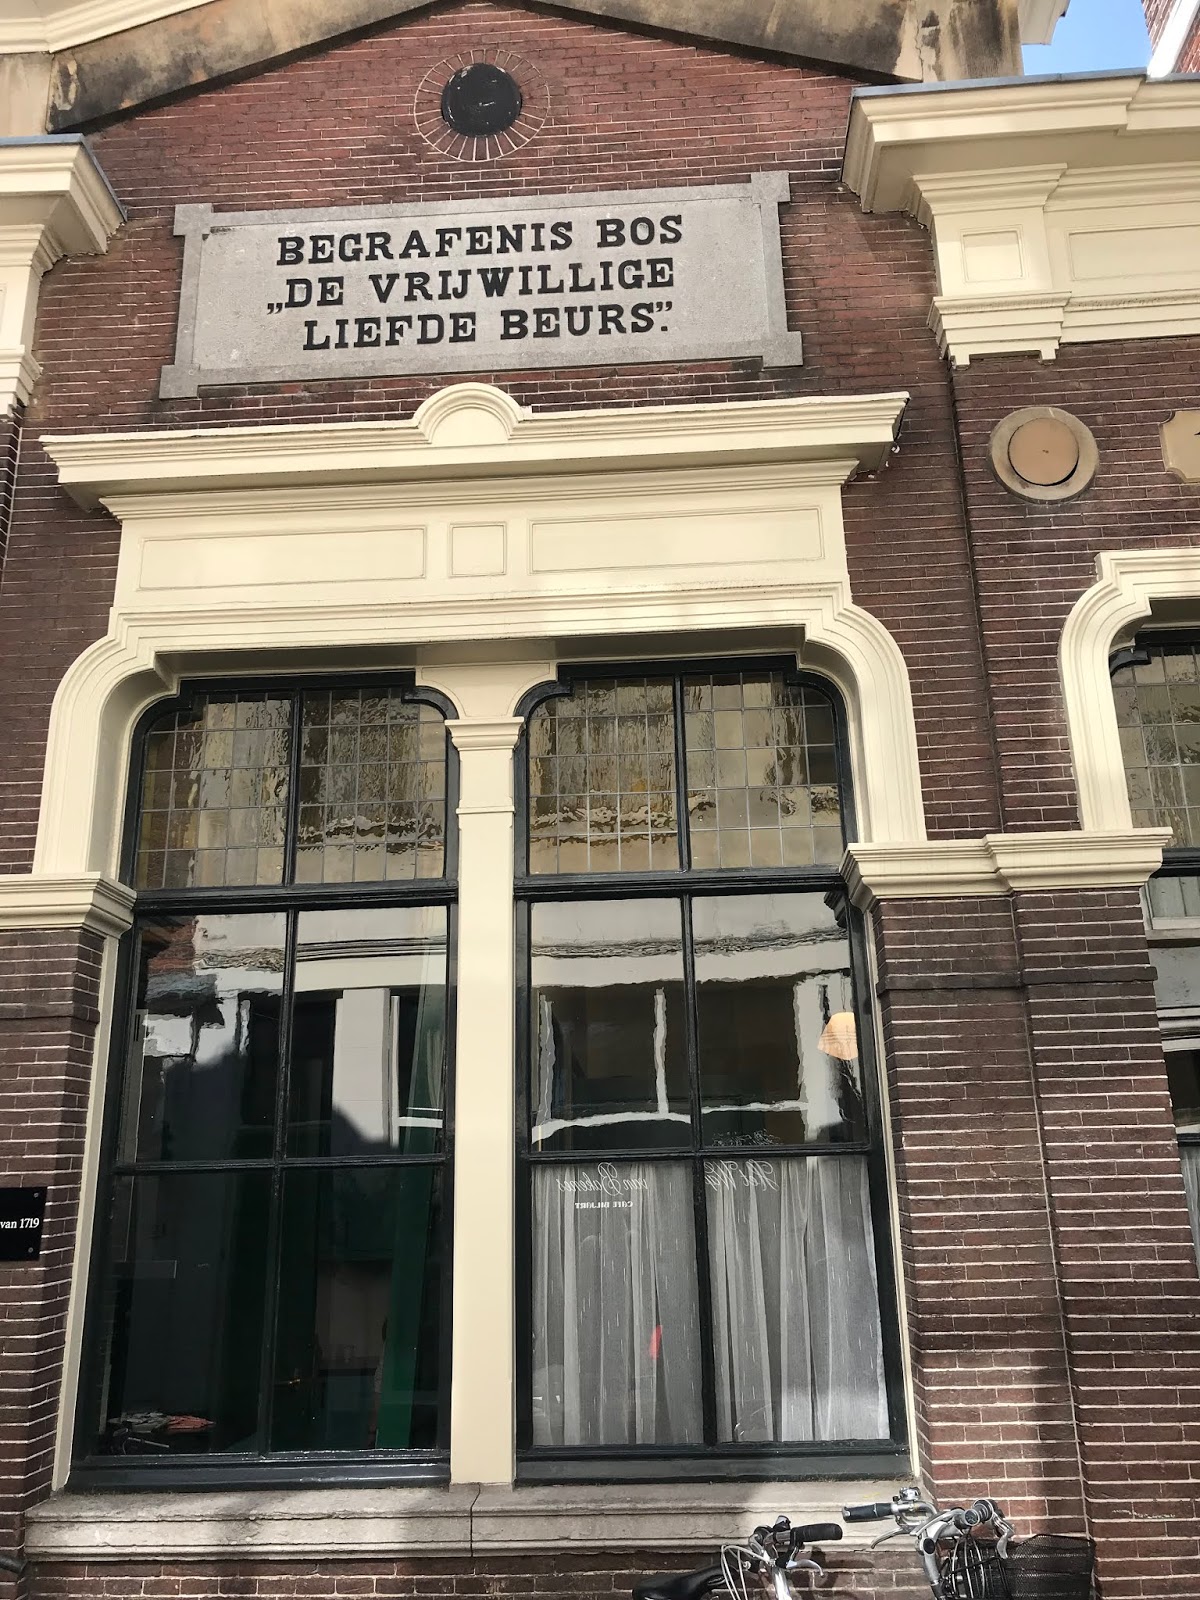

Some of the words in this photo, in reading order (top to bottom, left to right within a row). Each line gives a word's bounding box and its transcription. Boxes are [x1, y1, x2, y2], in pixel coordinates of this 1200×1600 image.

[276, 222, 573, 268] BEGRAFENIS
[597, 215, 682, 249] BOS
[368, 257, 674, 304] VRIJWILLIGE
[302, 313, 476, 351] LIEFDE
[0, 1221, 17, 1229] van
[19, 1218, 40, 1229] 1719
